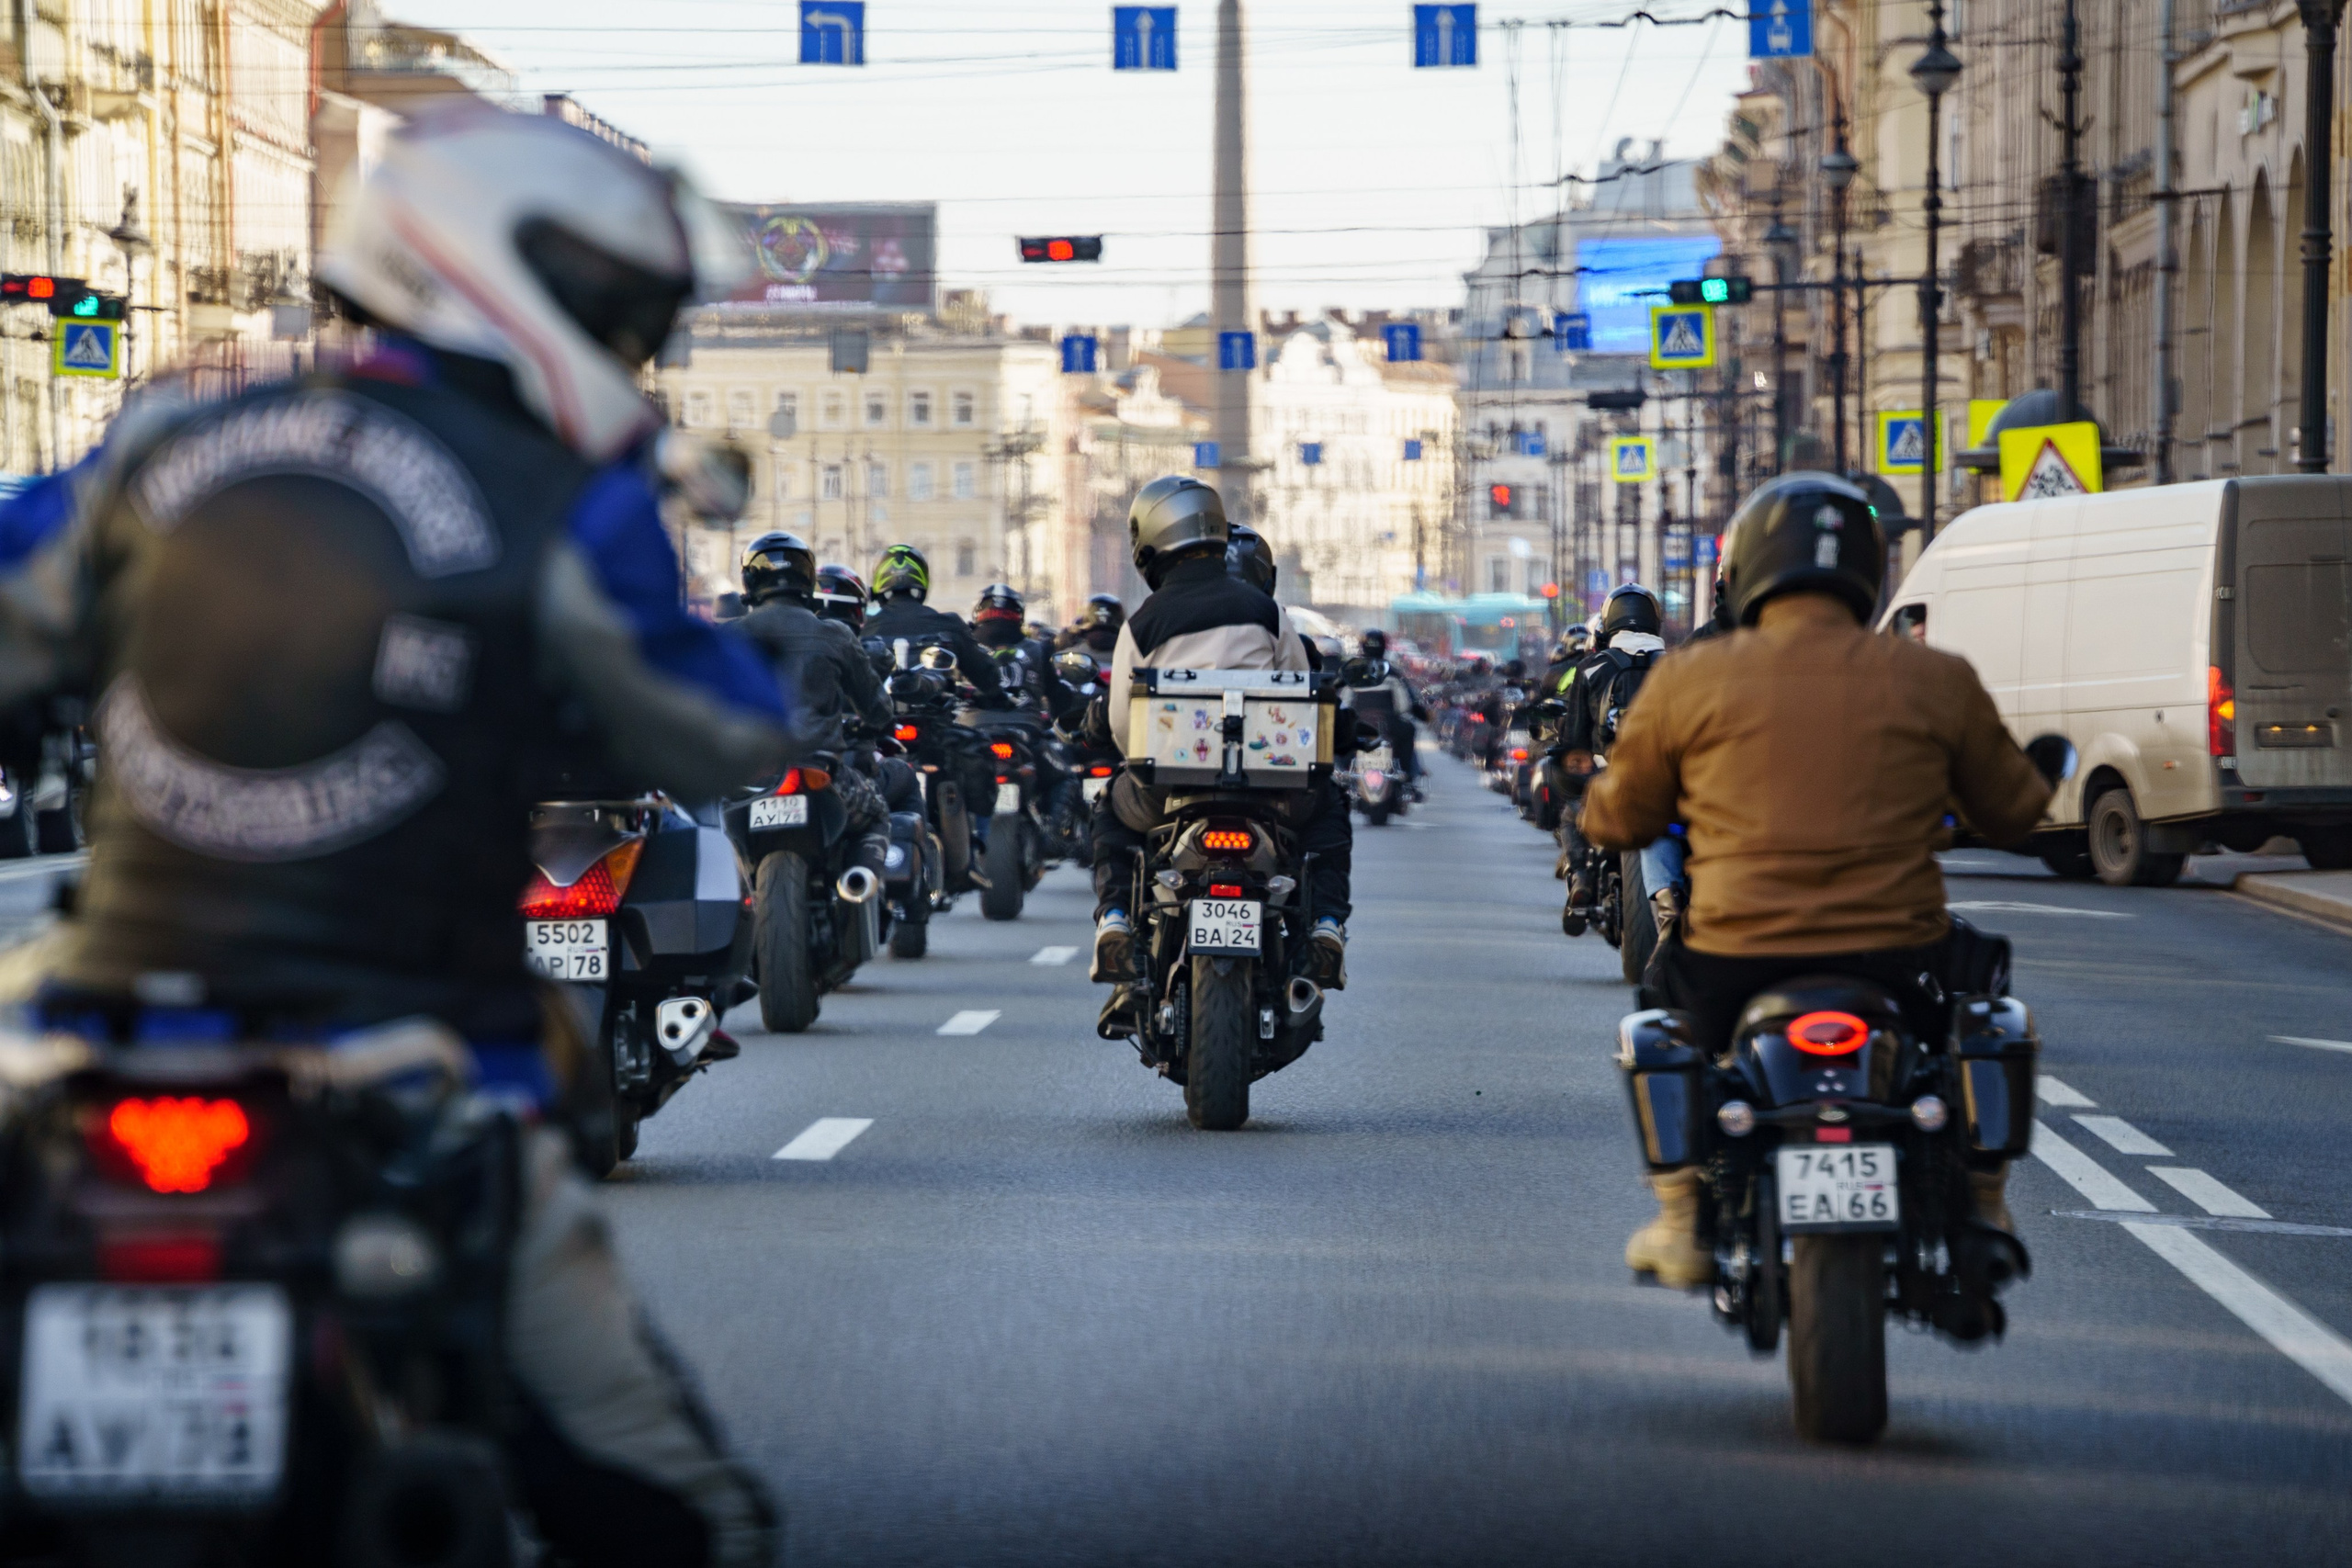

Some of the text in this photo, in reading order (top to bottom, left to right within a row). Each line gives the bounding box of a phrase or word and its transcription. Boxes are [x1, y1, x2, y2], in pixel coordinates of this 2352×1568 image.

[1202, 901, 1250, 919] 3046
[537, 922, 594, 944] 5502
[1194, 928, 1255, 946] ВА 24
[567, 945, 586, 953] RUS
[573, 955, 602, 976] 78
[1793, 1152, 1880, 1179] 7415
[1836, 1181, 1864, 1191] RUS
[1787, 1192, 1888, 1220] ЕА 66
